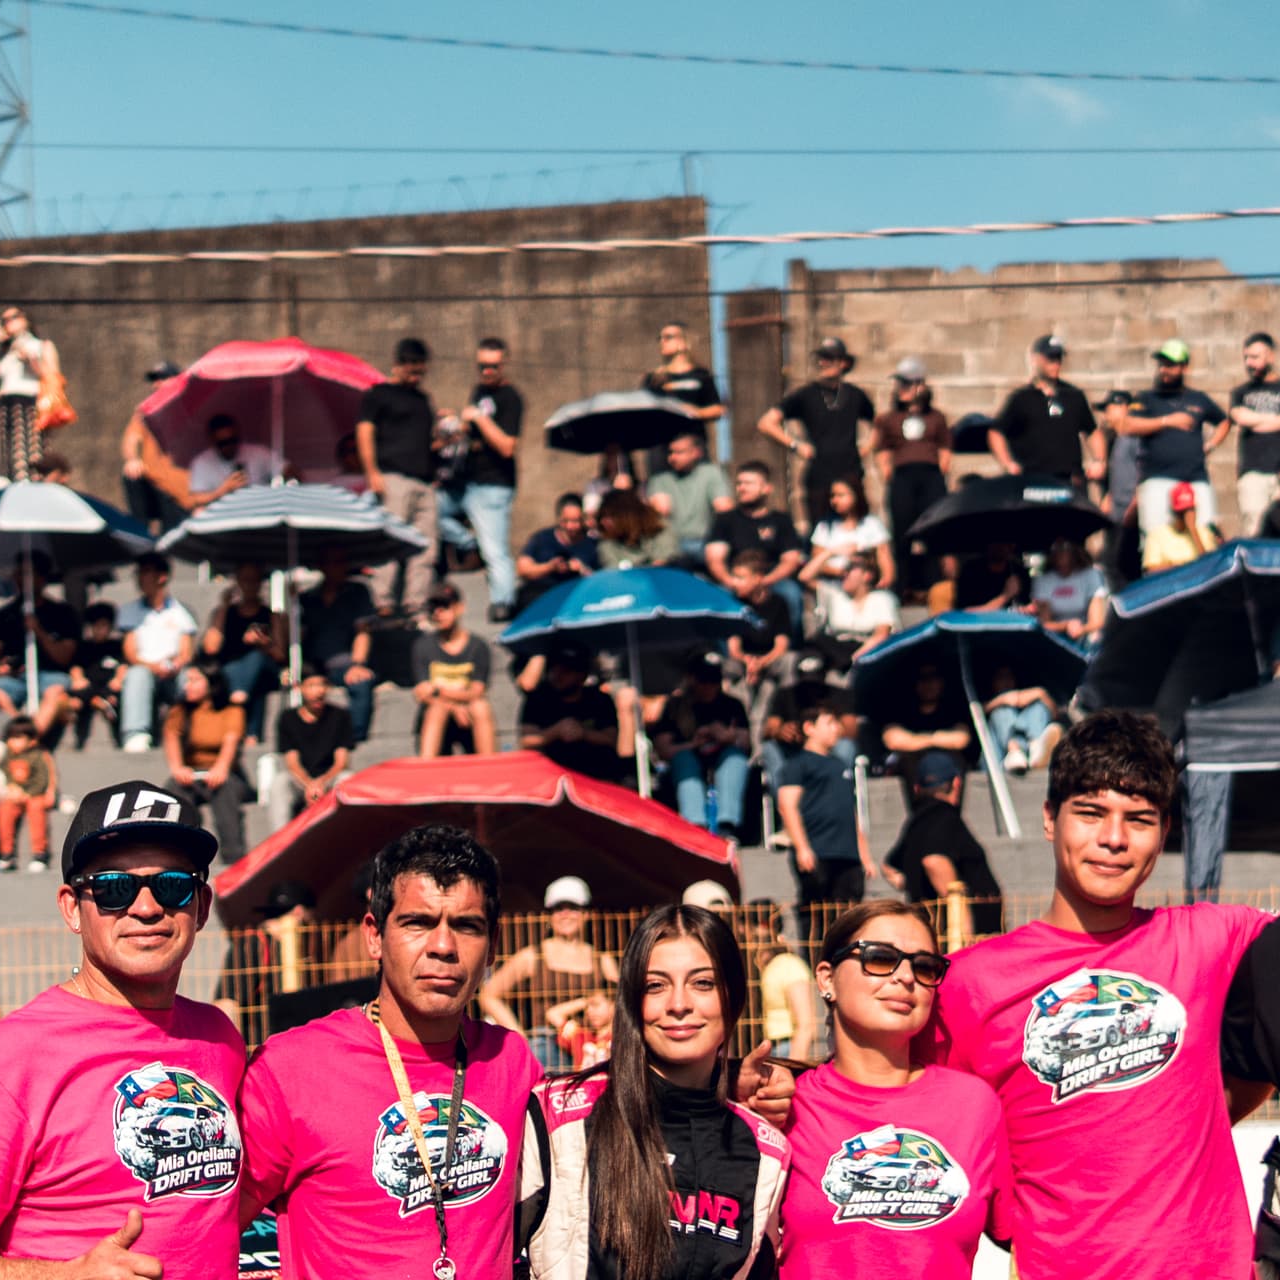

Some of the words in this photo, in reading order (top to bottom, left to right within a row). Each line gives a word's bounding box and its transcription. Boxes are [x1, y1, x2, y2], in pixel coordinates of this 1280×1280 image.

[1062, 1053, 1097, 1078] Mia
[1098, 1032, 1168, 1062] Orellana
[1060, 1058, 1120, 1095] DRIFT
[1120, 1046, 1165, 1071] GIRL
[156, 1153, 185, 1176] Mia
[186, 1147, 237, 1166] Orellana
[152, 1165, 204, 1194] DRIFT
[203, 1161, 236, 1179] GIRL
[457, 1170, 492, 1190] GIRL
[842, 1203, 901, 1217] DRIFT
[900, 1203, 941, 1215] GIRL
[849, 1190, 882, 1203] Mia
[884, 1188, 950, 1204] Orellana
